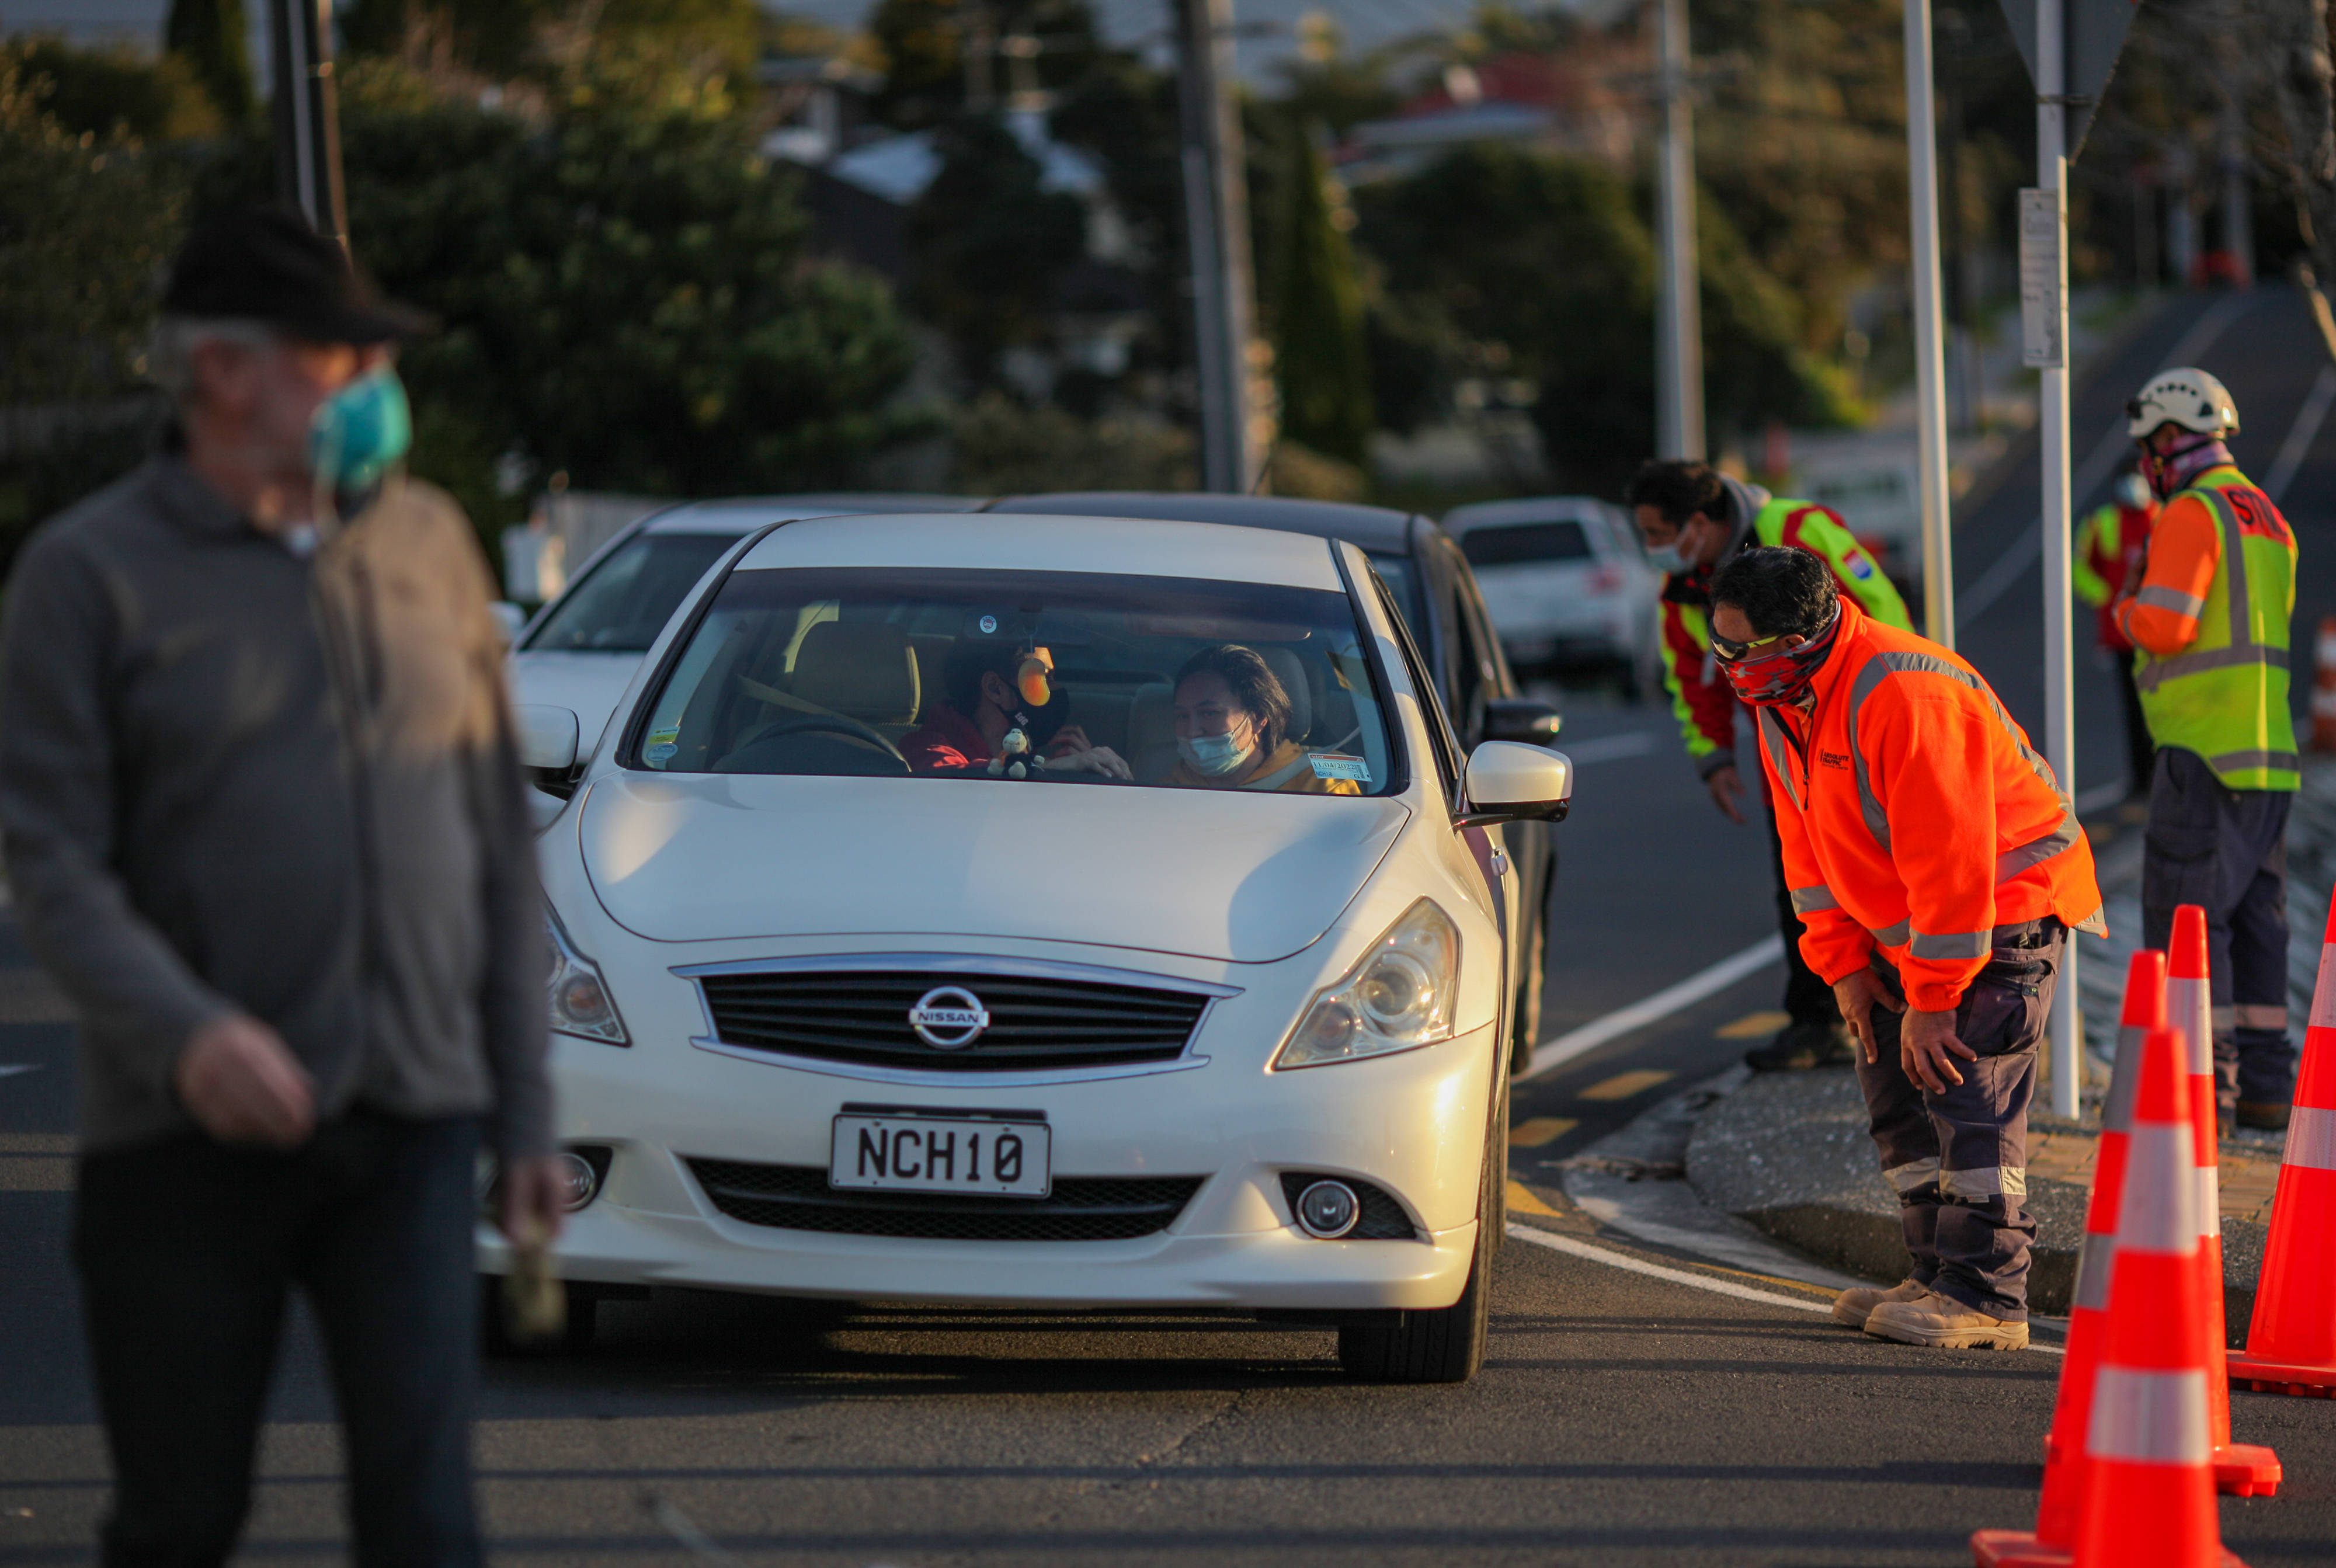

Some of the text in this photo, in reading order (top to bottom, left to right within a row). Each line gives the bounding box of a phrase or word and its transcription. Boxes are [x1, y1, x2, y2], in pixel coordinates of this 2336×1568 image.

[1824, 752, 1850, 761] ABSOLUTE
[1313, 762, 1355, 770] 11/04/2022
[918, 1012, 979, 1023] NISSAN
[858, 1127, 1023, 1182] NCH10
